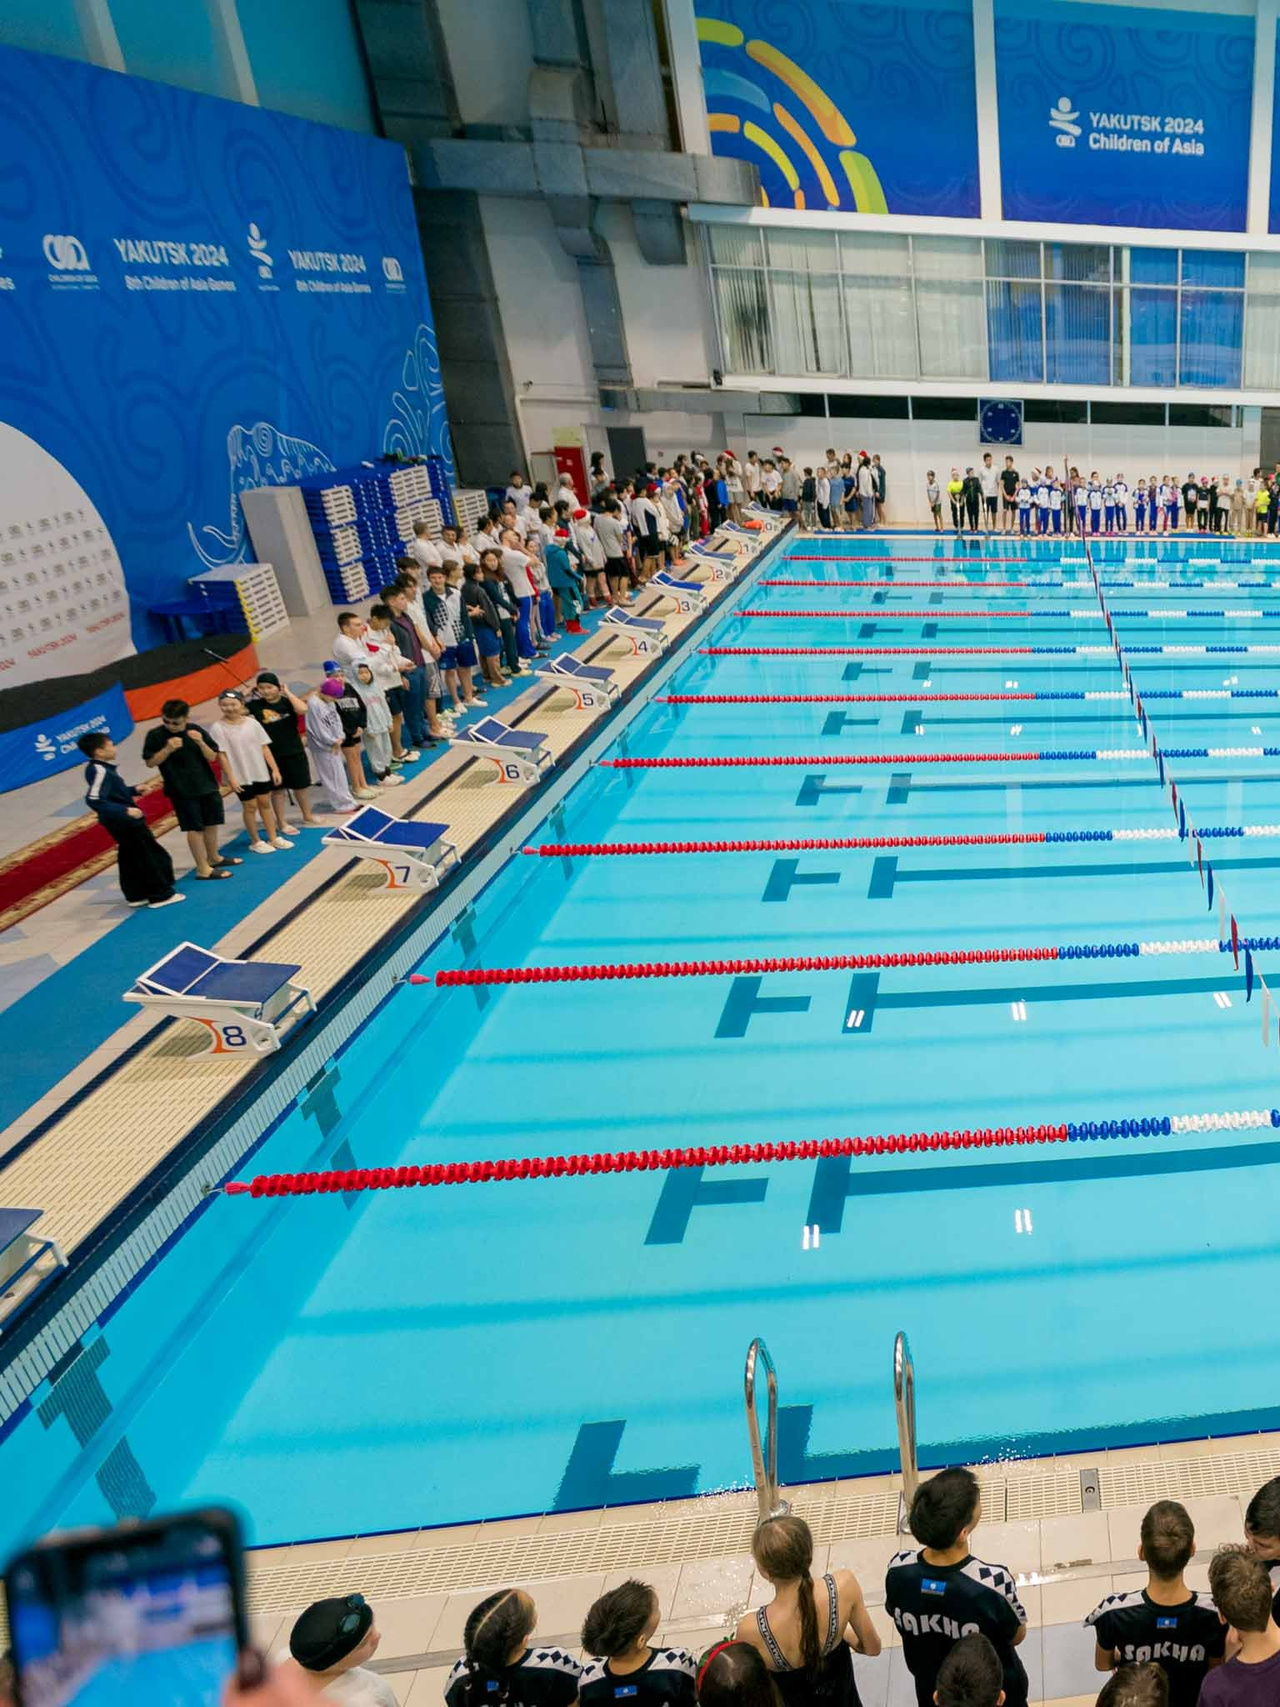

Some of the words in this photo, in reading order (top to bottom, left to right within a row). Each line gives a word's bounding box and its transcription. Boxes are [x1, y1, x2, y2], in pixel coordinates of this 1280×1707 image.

[1089, 112, 1161, 132] YAKUTSK
[1164, 117, 1204, 134] 2024
[1089, 132, 1151, 152] Children
[1153, 137, 1169, 153] of
[1171, 138, 1205, 155] Asia
[113, 238, 191, 266] YAKUTSK
[190, 244, 229, 266] 2024
[287, 249, 341, 272] YAKUTSK
[340, 254, 367, 273] 2024
[716, 570, 723, 579] 2
[681, 601, 691, 612] 3
[638, 640, 648, 652] 4
[582, 693, 594, 706] 5
[506, 764, 520, 779] 6
[395, 866, 411, 883] 7
[222, 1025, 247, 1046] 8
[1124, 1641, 1206, 1662] SAKHA
